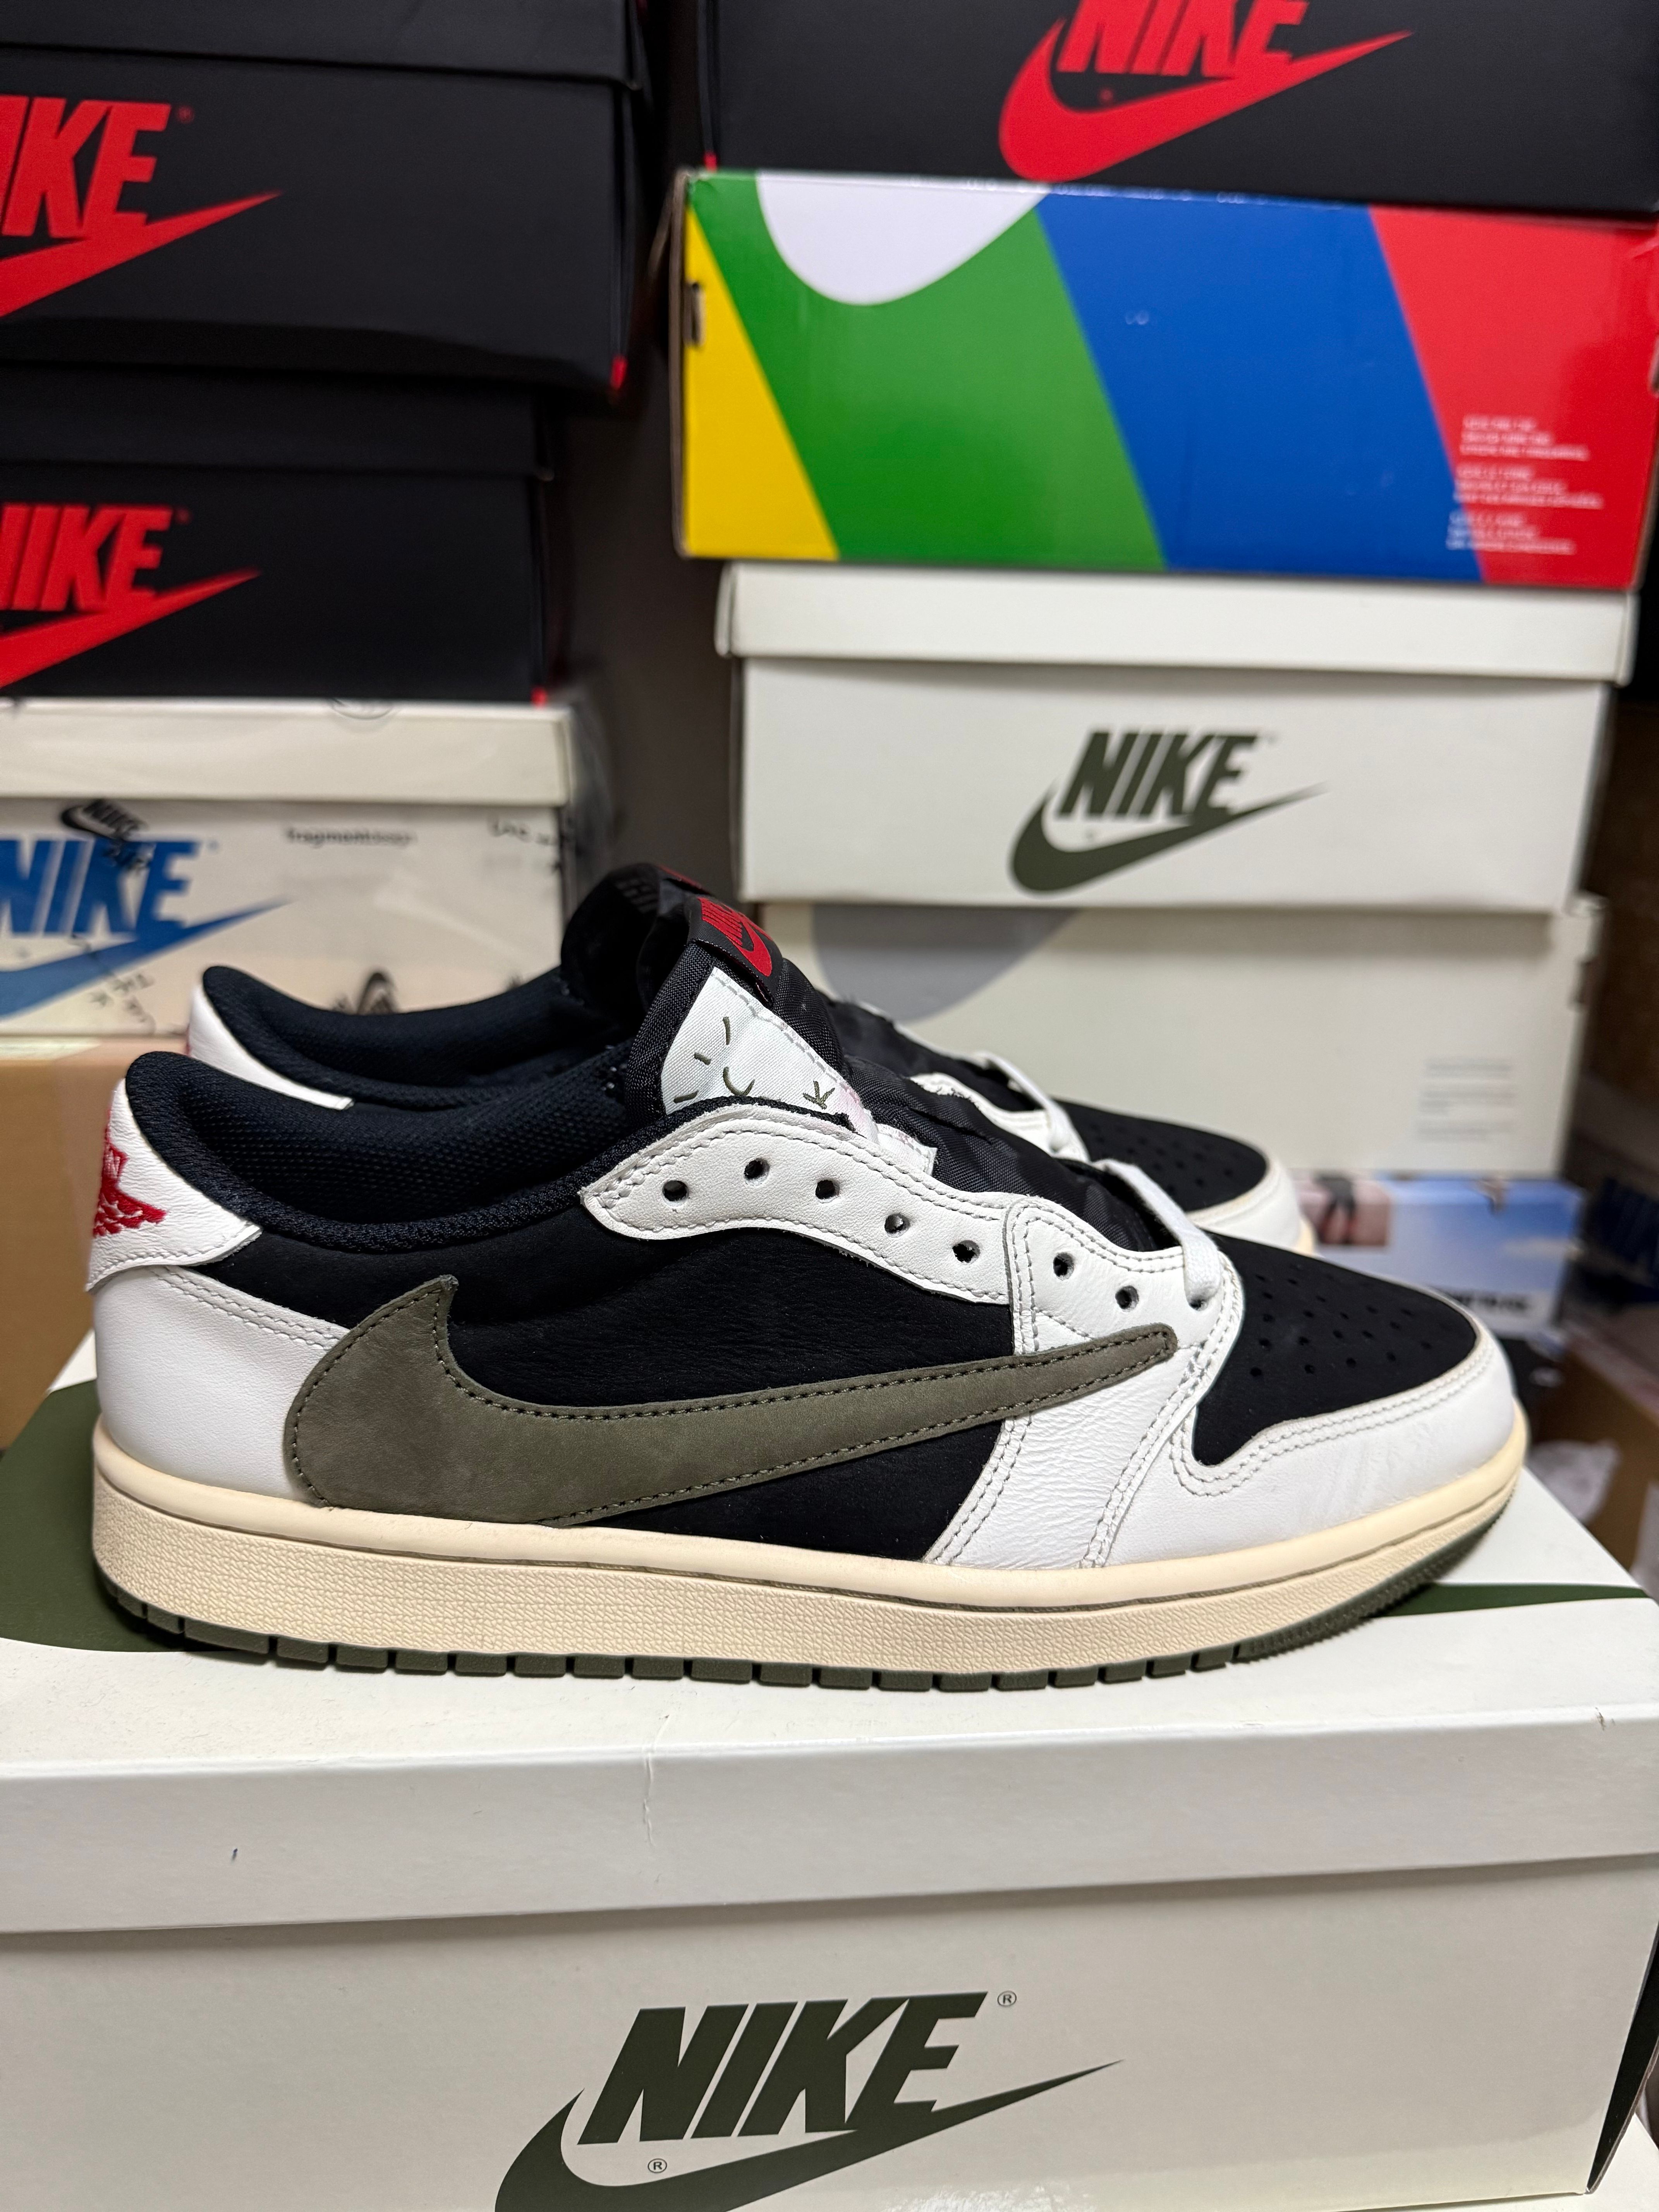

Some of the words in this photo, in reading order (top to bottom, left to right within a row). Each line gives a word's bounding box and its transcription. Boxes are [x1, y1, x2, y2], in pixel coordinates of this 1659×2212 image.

[1056, 0, 1308, 77] NIKE
[0, 94, 172, 238] IKE
[1056, 730, 1257, 820] NIKE
[577, 1990, 988, 2145] NIKE
